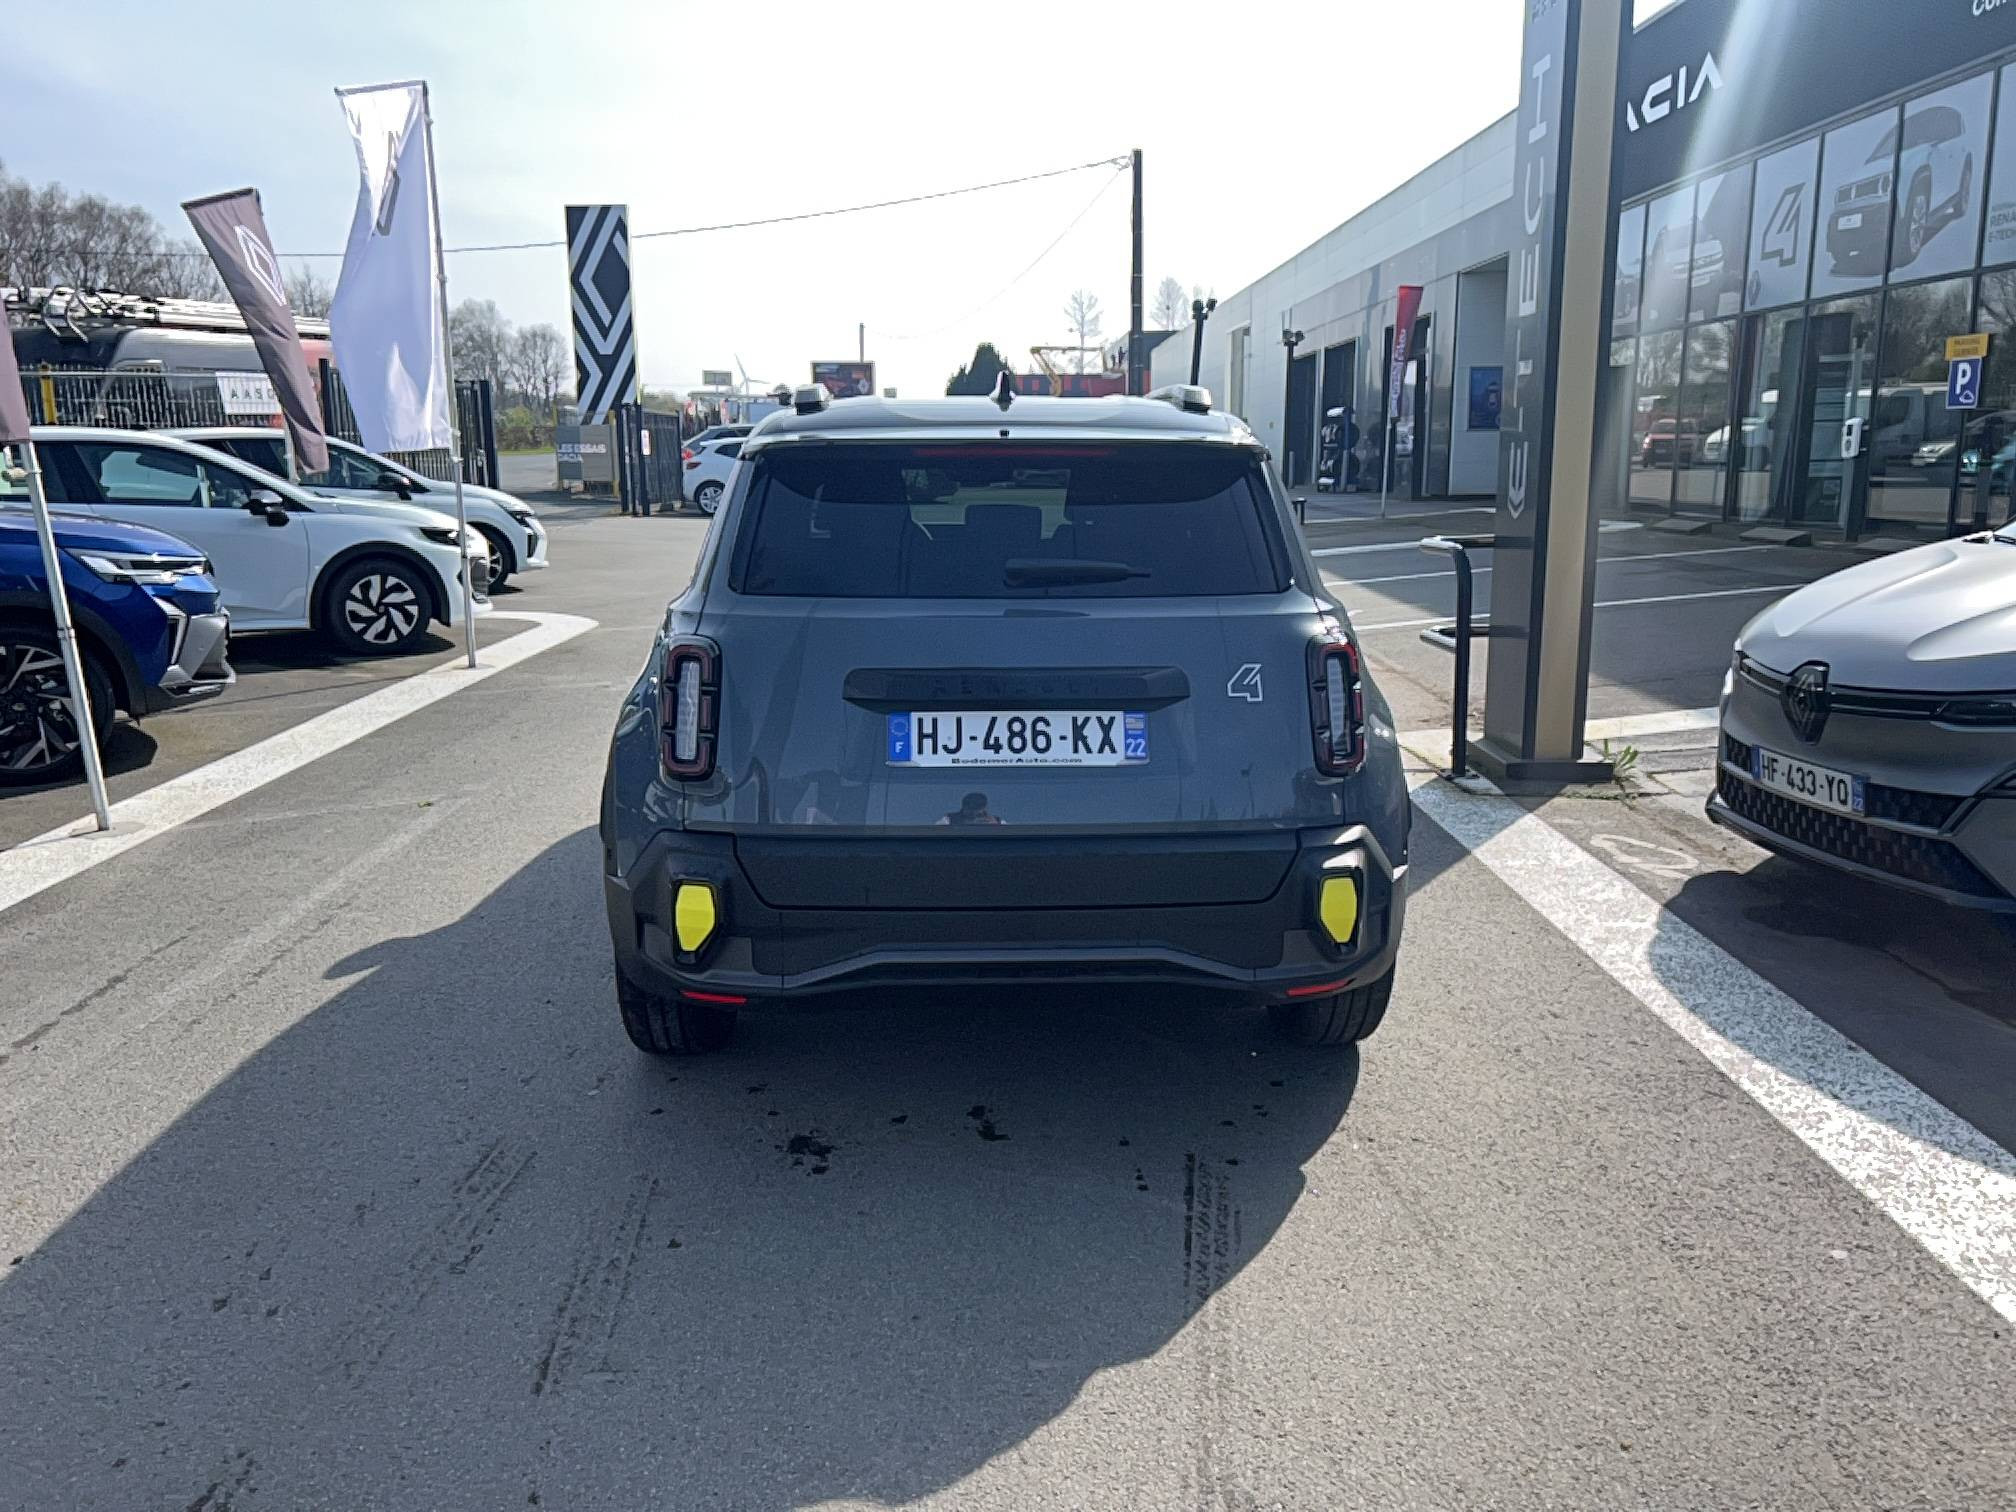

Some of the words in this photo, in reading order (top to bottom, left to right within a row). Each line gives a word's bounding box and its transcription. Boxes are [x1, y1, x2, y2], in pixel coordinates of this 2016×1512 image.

[1955, 362, 1972, 395] P
[895, 741, 905, 753] F
[916, 715, 1118, 756] HJ-486-KX
[1126, 738, 1147, 758] 22
